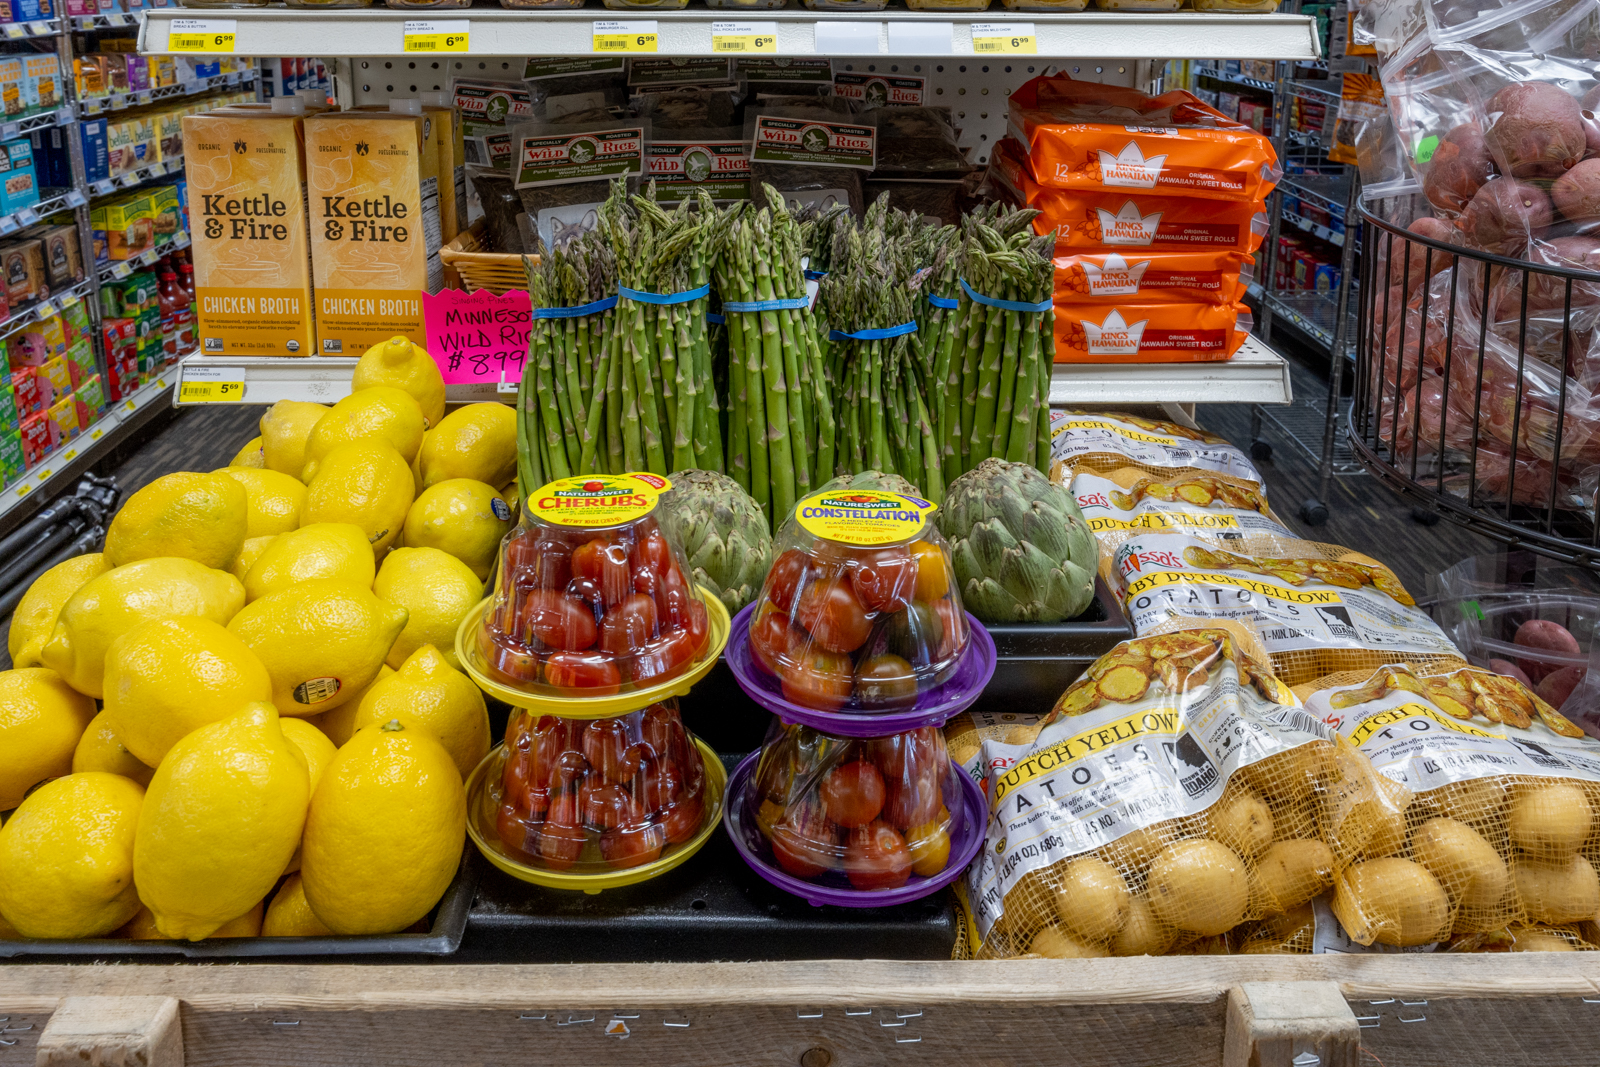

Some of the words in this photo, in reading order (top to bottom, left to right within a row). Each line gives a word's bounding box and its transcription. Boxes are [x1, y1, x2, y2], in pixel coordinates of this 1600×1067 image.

[834, 85, 862, 98] WILD
[892, 90, 920, 102] RICE
[457, 98, 484, 110] WILD
[763, 130, 798, 143] WILD
[836, 135, 870, 148] RICE
[9, 143, 30, 155] KETO
[319, 145, 342, 153] ORGANIC
[528, 149, 564, 159] WILD
[603, 141, 637, 152] RICE
[1055, 163, 1069, 178] 12
[1115, 163, 1146, 173] KING'S
[1106, 170, 1155, 182] HAWAIIAN
[1158, 176, 1195, 185] HAWAIIAN
[1196, 179, 1220, 187] SWEET
[1221, 181, 1243, 190] ROLLS
[202, 193, 286, 217] Kettle
[322, 195, 407, 219] Kettle
[205, 218, 224, 239] &
[230, 218, 287, 240] Fire
[325, 220, 344, 241] &
[350, 220, 408, 242] Fire
[1057, 224, 1070, 237] 12
[1105, 228, 1152, 239] HAWAIIAN
[1114, 221, 1143, 231] KING'S
[1155, 234, 1189, 242] HAWAIIAN
[1101, 272, 1130, 280] KING'S
[1092, 279, 1138, 289] HAWAIIAN
[1202, 281, 1220, 289] ROLLS
[204, 297, 256, 315] CHICKEN
[260, 298, 300, 315] BROTH
[323, 298, 375, 316] CHICKEN
[380, 299, 419, 316] BROTH
[446, 308, 532, 326] MINNESO
[439, 329, 491, 352] WILD
[1091, 339, 1138, 348] HAWAIIAN
[1101, 332, 1129, 340] KING'S
[1201, 340, 1223, 348] ROLLS
[448, 350, 525, 375] $8.99
[1051, 430, 1146, 449] TATOES
[1052, 422, 1104, 438] DUTCH
[1109, 426, 1171, 445] YELLOW
[1171, 450, 1191, 458] IDAHO
[558, 489, 630, 497] NATURESWEET
[538, 494, 647, 509] CHERUBS
[823, 500, 899, 508] NATURESWEET
[802, 507, 920, 524] CONSTELLATION
[1092, 513, 1151, 531] DUTCH
[1155, 515, 1231, 528] YELLOW
[1126, 575, 1159, 600] ABY
[1168, 572, 1240, 586] DUTCH
[1246, 580, 1331, 603] YELLOW
[1136, 588, 1300, 616] OTATOES
[1193, 609, 1212, 618] buttery
[1228, 609, 1241, 618] offer
[1198, 704, 1222, 729] GREAT
[1209, 717, 1230, 744] CONNECT
[1214, 728, 1228, 743] YOUR
[1350, 708, 1412, 748] UTCH
[1389, 741, 1408, 752] spuds
[1408, 736, 1423, 745] offer
[996, 743, 1076, 800] DUTCH
[1077, 712, 1175, 752] YELLOW
[1390, 749, 1409, 759] flavor
[1424, 760, 1442, 774] U.S.
[1181, 771, 1199, 784] GROWN
[1185, 768, 1216, 794] IDAHO
[1009, 819, 1028, 831] These
[1028, 810, 1050, 826] buttery
[1068, 796, 1083, 809] offer
[1071, 806, 1084, 818] with
[1098, 814, 1116, 830] NO.
[1008, 851, 1022, 871] (24
[1022, 844, 1040, 859] OZ)
[1040, 835, 1064, 853] 680g
